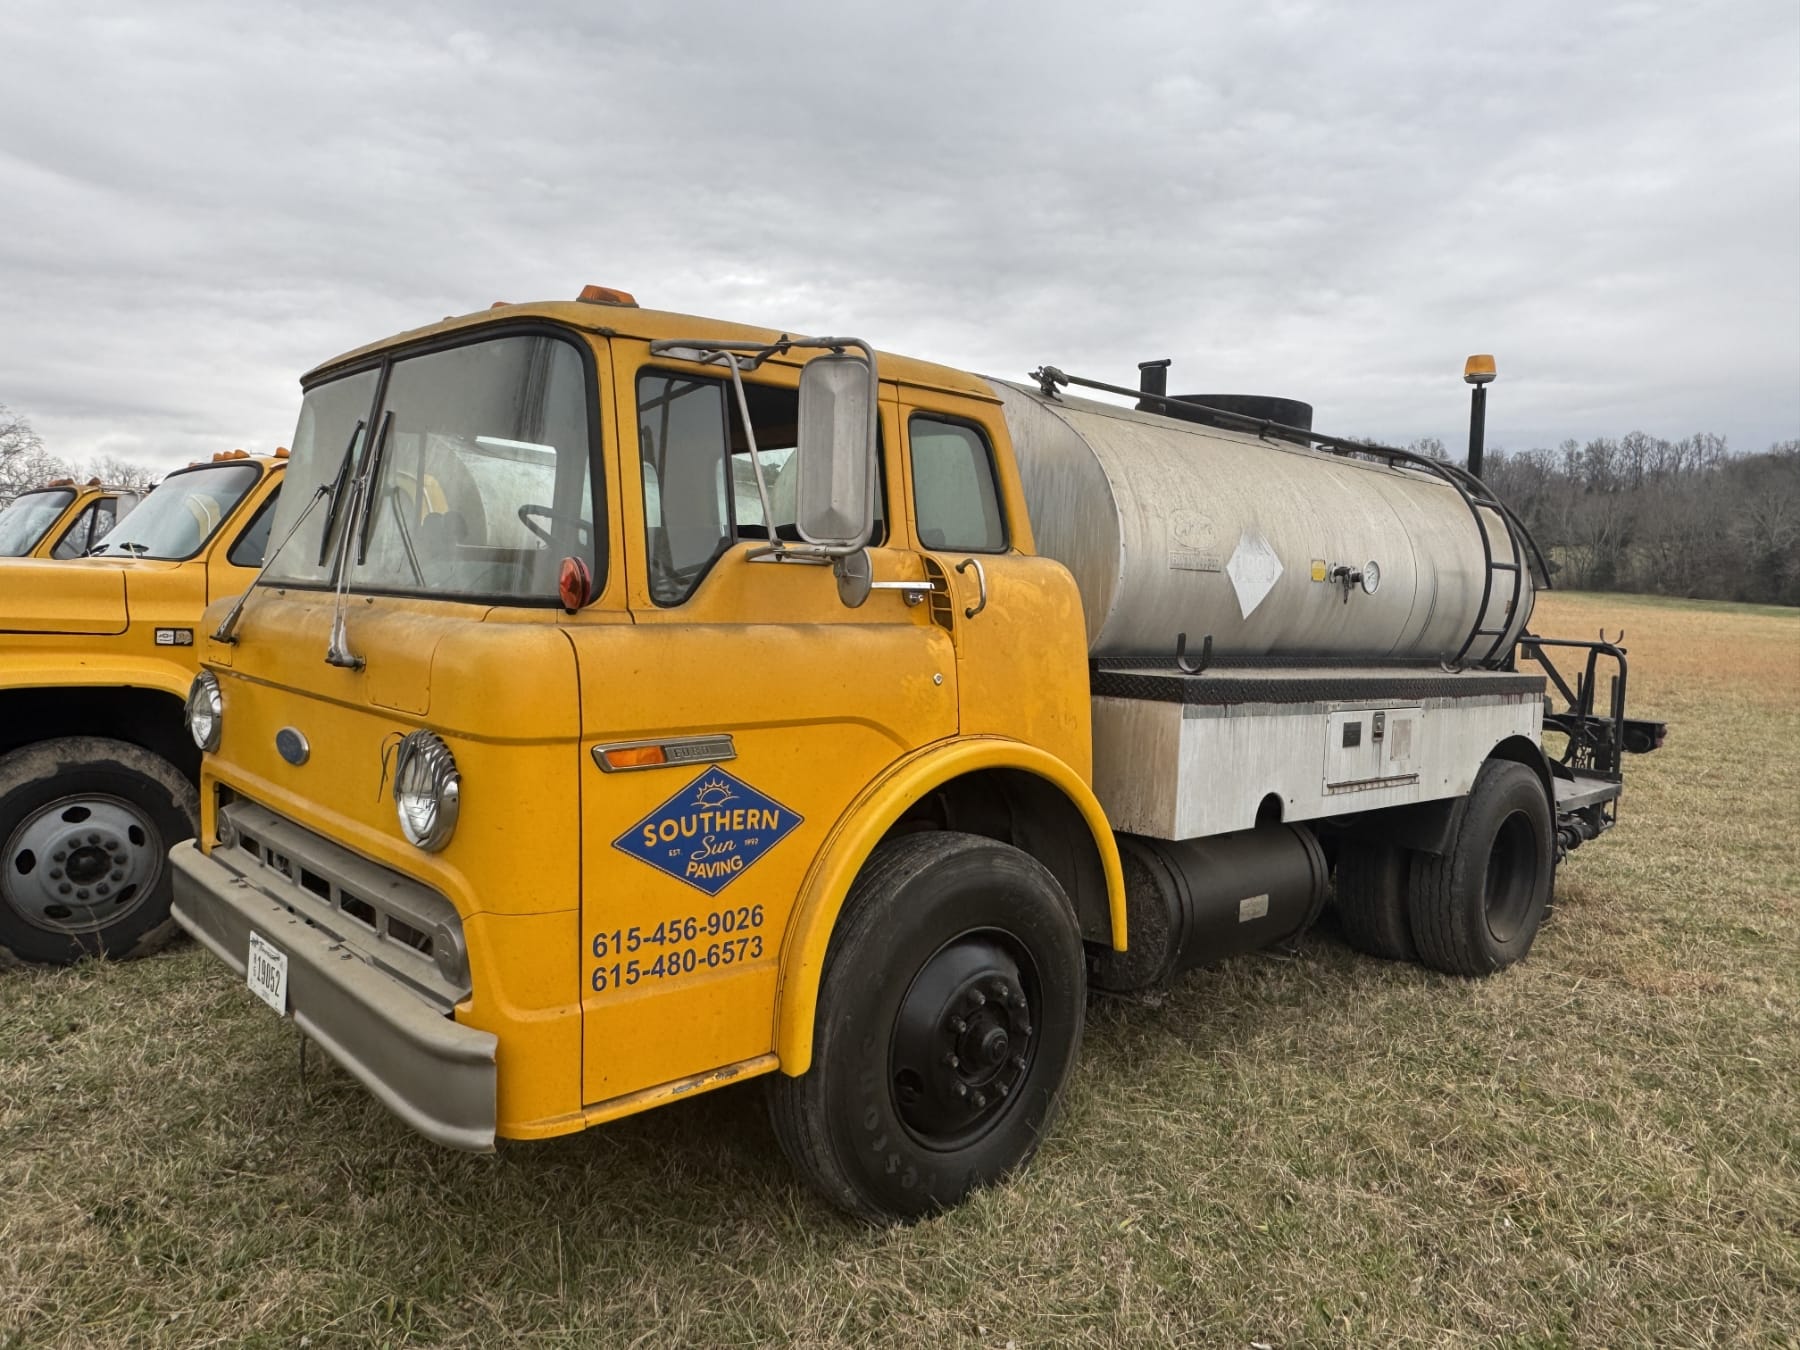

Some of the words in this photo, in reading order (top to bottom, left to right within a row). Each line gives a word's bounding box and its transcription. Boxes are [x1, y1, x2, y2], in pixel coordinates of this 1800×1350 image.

[643, 809, 780, 847] SOUTHERN
[690, 835, 736, 860] Sun
[685, 855, 743, 879] PAVING
[592, 904, 764, 958] 615-456-9026
[257, 955, 280, 998] 19052
[591, 935, 763, 992] 615-480-6573
